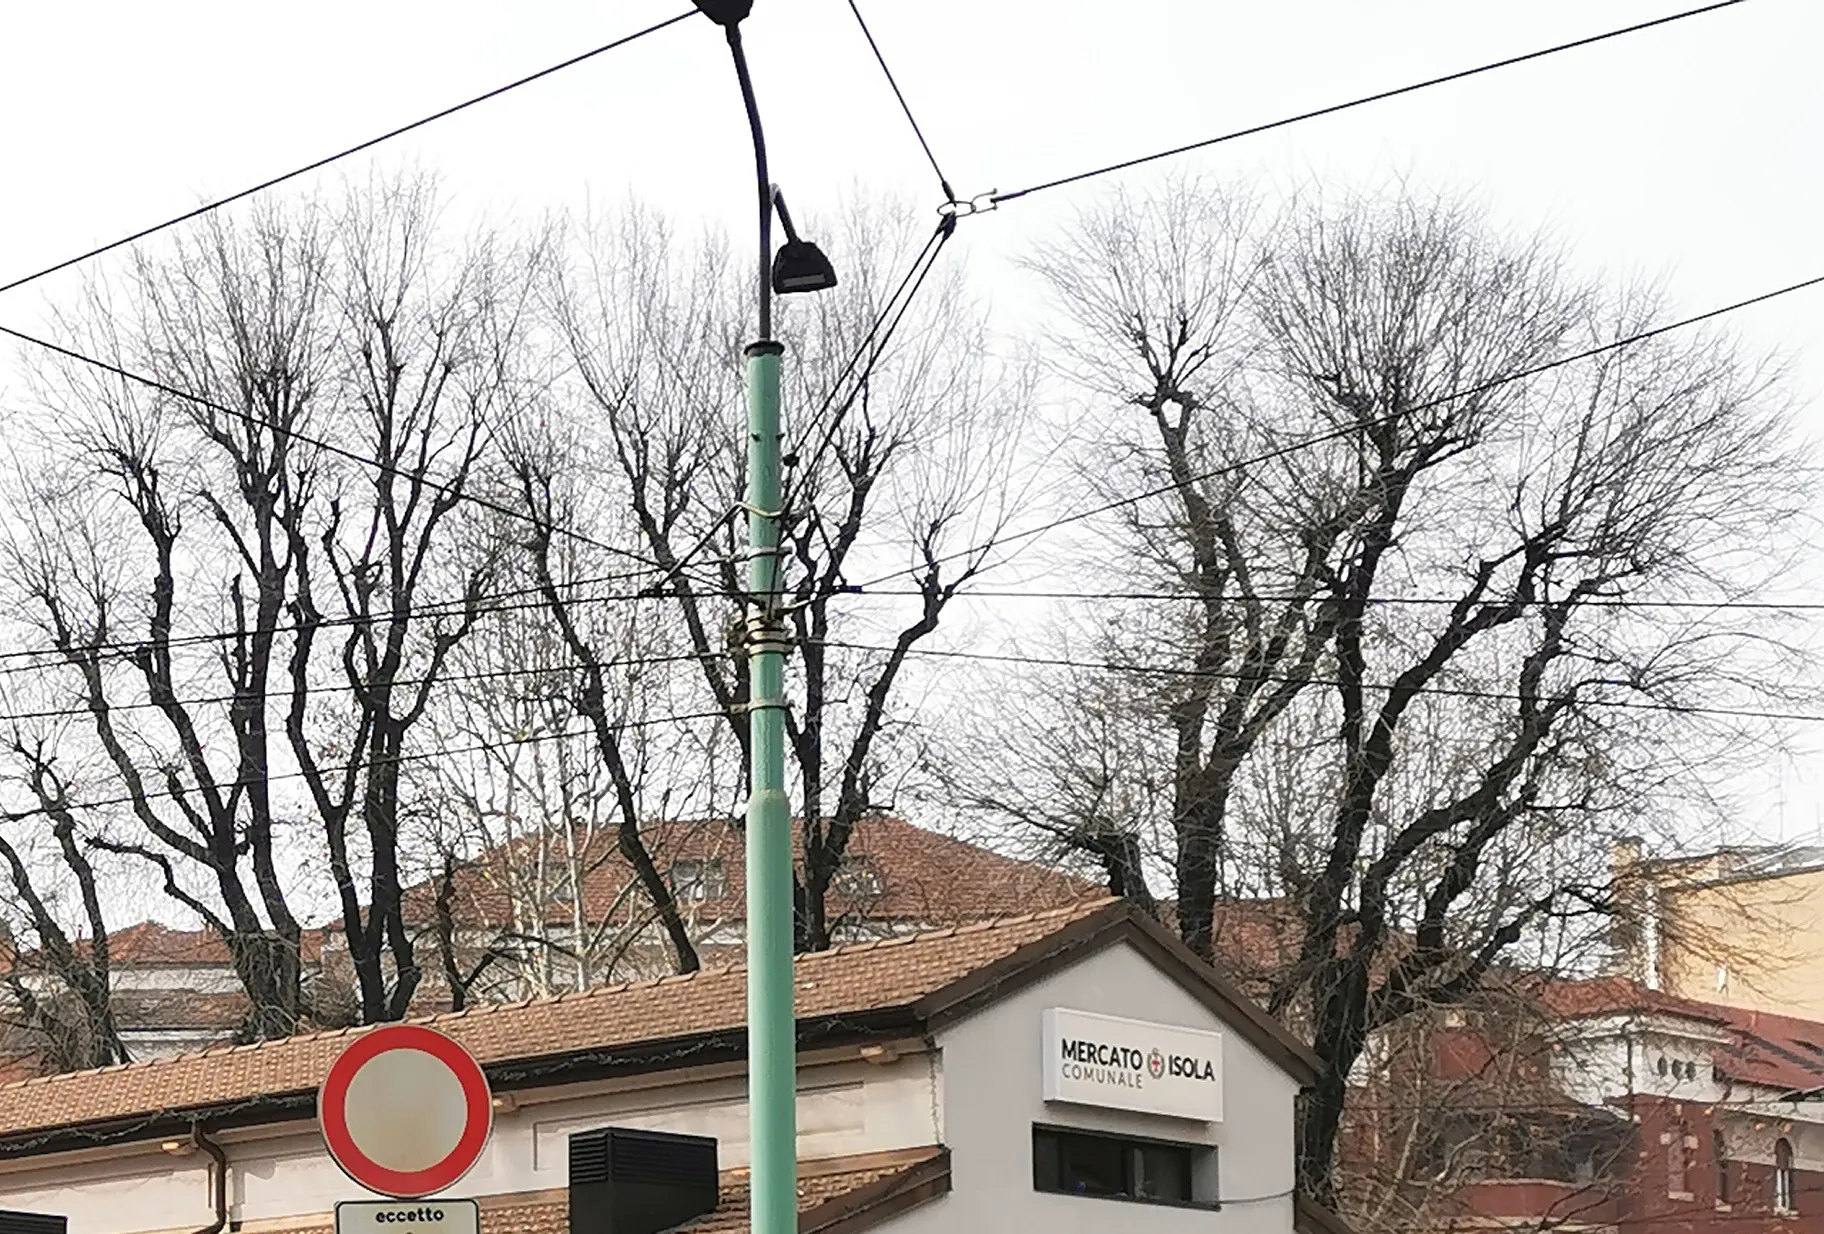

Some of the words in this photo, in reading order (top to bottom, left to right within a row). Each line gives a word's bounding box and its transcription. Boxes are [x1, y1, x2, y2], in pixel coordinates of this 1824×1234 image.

[1061, 1038, 1144, 1071] MERCATO
[1168, 1054, 1216, 1082] ISOLA
[1061, 1063, 1143, 1090] COMUNALE
[375, 1207, 445, 1223] eccetto
